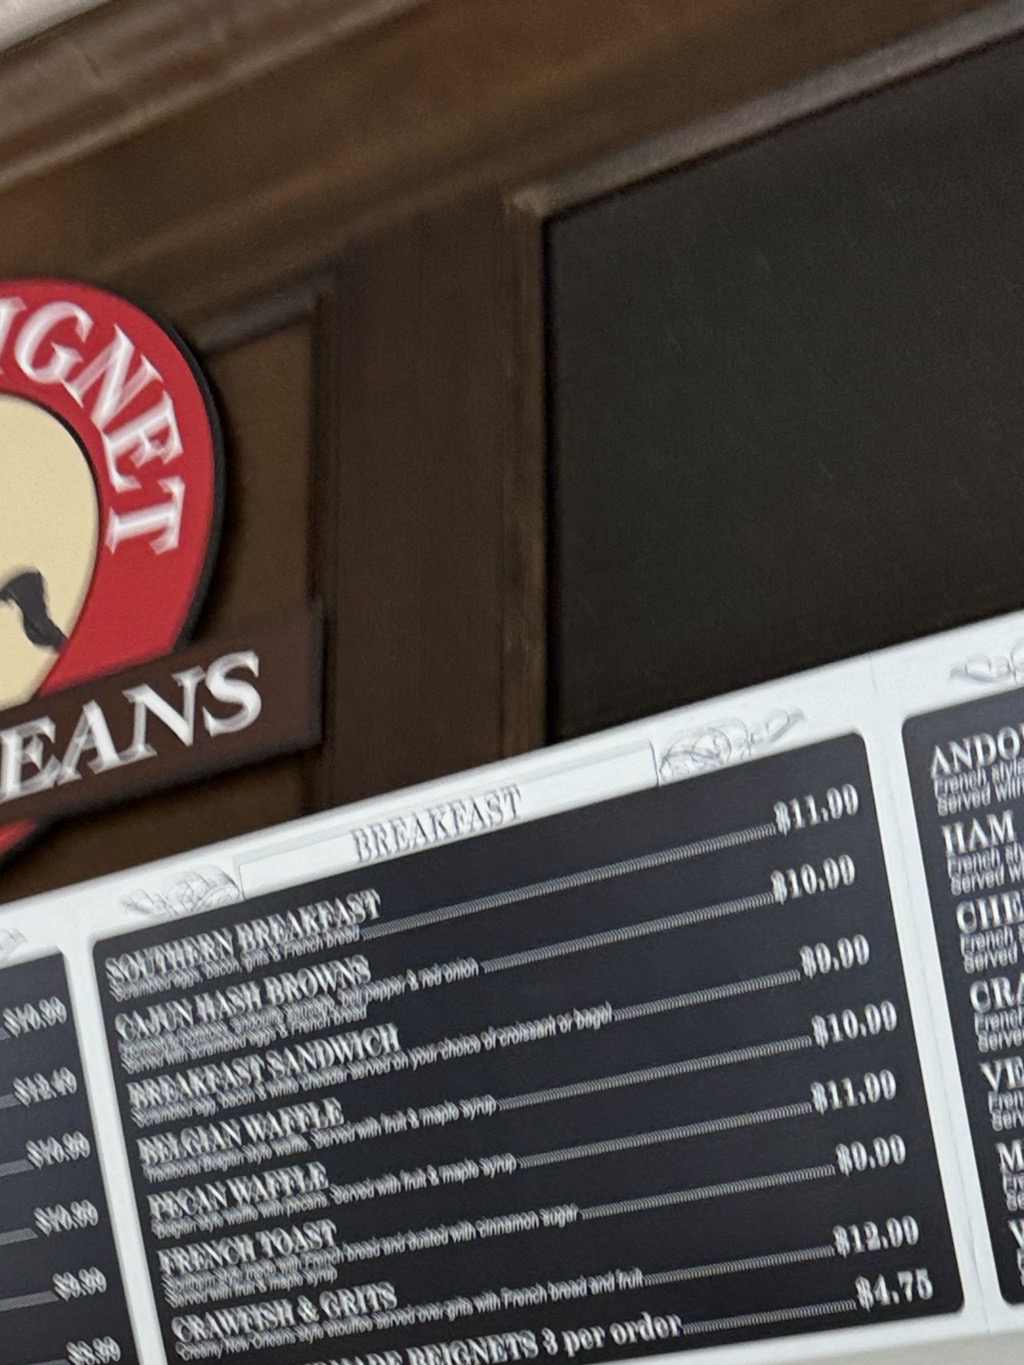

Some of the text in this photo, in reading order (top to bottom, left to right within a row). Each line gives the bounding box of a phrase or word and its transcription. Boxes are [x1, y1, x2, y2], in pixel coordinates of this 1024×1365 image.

[930, 722, 1024, 780] ANDO
[351, 784, 523, 864] BREAKFAST
[942, 809, 1018, 856] HAM
[235, 887, 383, 953] BREAKFAST
[956, 890, 1024, 935] CHE
[113, 995, 195, 1042] CAJUN
[193, 978, 265, 1024] HASH
[263, 951, 372, 1006] BROWNS
[264, 1020, 402, 1078] SANDWICH
[436, 1031, 482, 1060] choice
[495, 1014, 558, 1047] croissant
[571, 1000, 615, 1033] bagel
[239, 1095, 345, 1144] WAFFLE
[378, 1107, 408, 1135] fruit
[417, 1097, 461, 1130] maple
[458, 1092, 498, 1121] syrup
[225, 1159, 330, 1206] WAFFLE
[398, 1164, 428, 1192] fruit
[436, 1156, 480, 1187] maple
[478, 1151, 518, 1179] syrup
[254, 1217, 340, 1260] TOAST
[447, 1218, 477, 1243] with
[474, 1207, 540, 1238] cinnamon
[538, 1202, 581, 1230] sugar
[169, 1298, 295, 1344] CRAWFISH
[294, 1292, 320, 1324] &
[318, 1280, 399, 1319] GRITS
[499, 1280, 549, 1310] French
[546, 1274, 589, 1303] bread
[586, 1270, 616, 1296] and
[614, 1265, 645, 1291] fruit
[560, 1324, 609, 1358] per
[606, 1306, 684, 1346] order
[853, 1265, 936, 1311] $4.75
